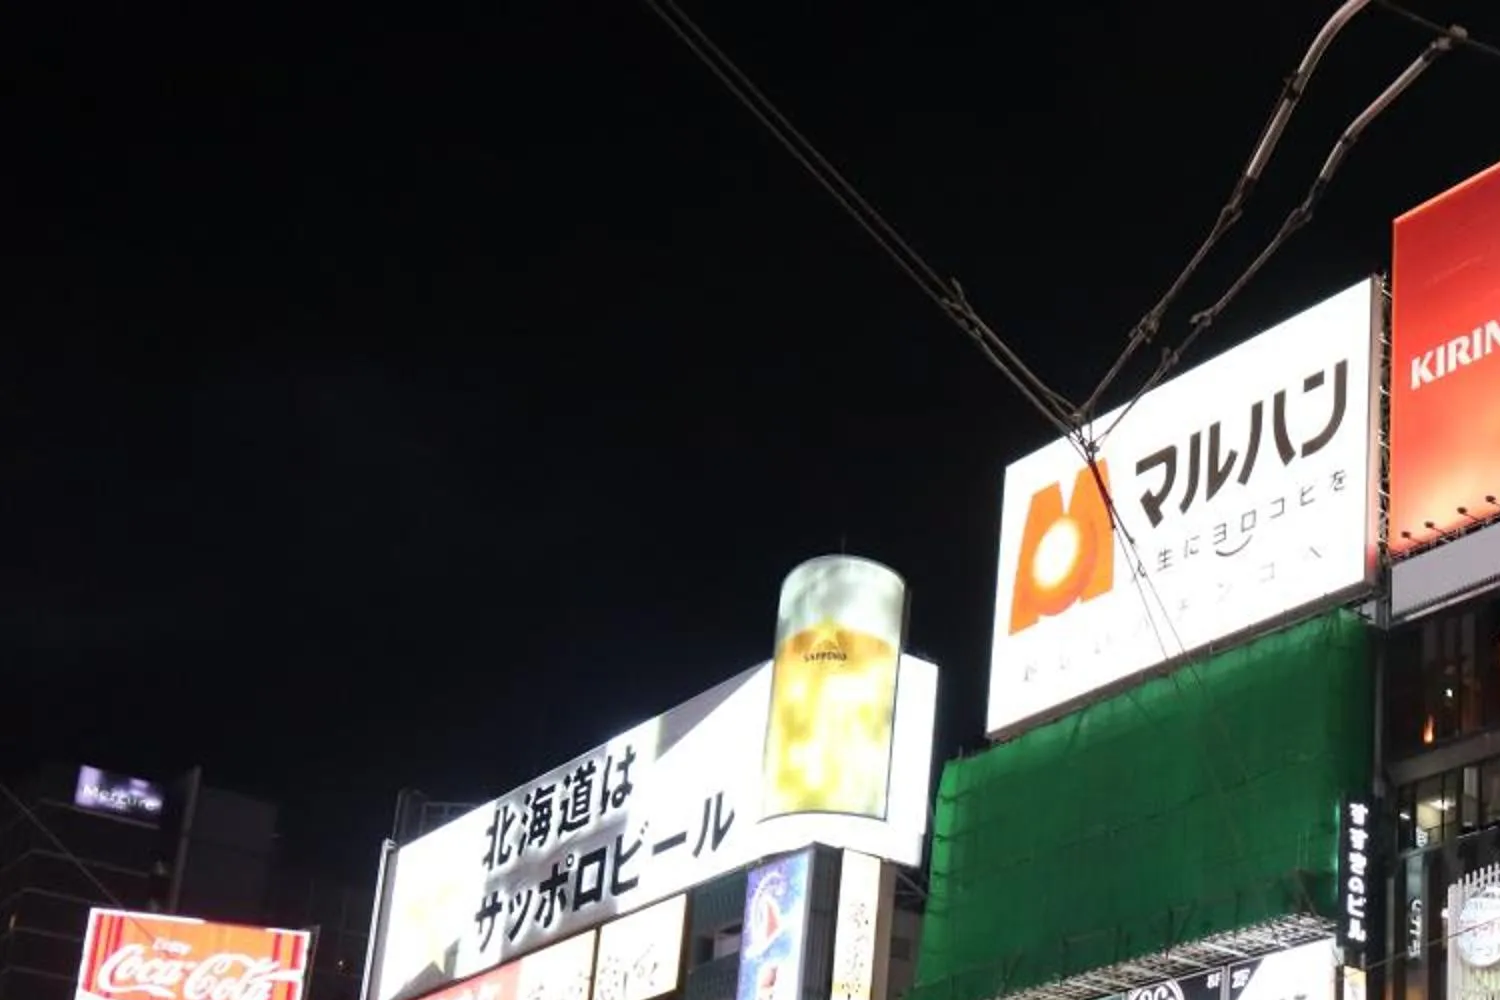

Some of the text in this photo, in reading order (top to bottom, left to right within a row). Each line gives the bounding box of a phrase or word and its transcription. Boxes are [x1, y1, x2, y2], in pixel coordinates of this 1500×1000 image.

[1135, 358, 1349, 528] マルハン
[474, 788, 736, 955] サッポロビール
[480, 744, 636, 873] 北海道は
[1347, 803, 1369, 943] すすきのビル
